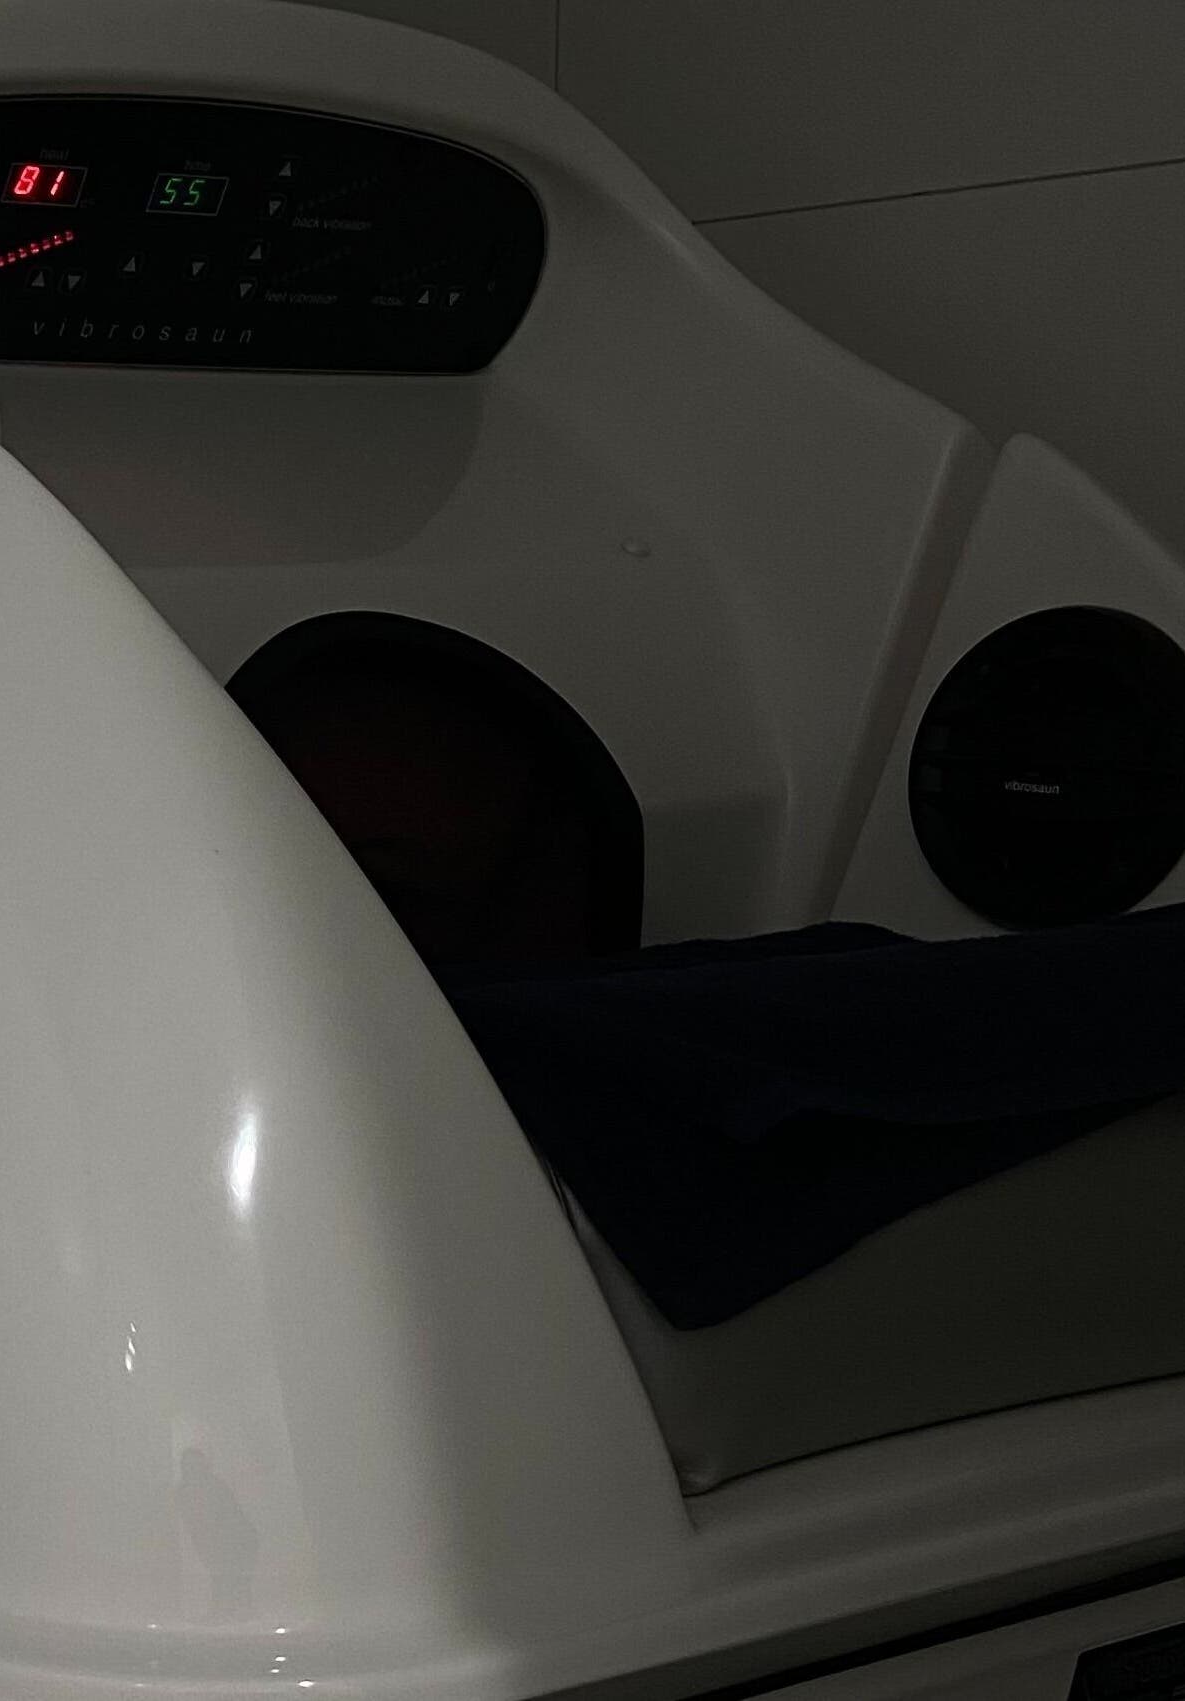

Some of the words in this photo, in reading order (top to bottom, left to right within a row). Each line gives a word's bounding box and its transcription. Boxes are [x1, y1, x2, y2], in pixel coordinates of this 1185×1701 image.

[14, 165, 65, 196] 81
[159, 177, 206, 206] 55
[32, 312, 256, 344] vibrosaun
